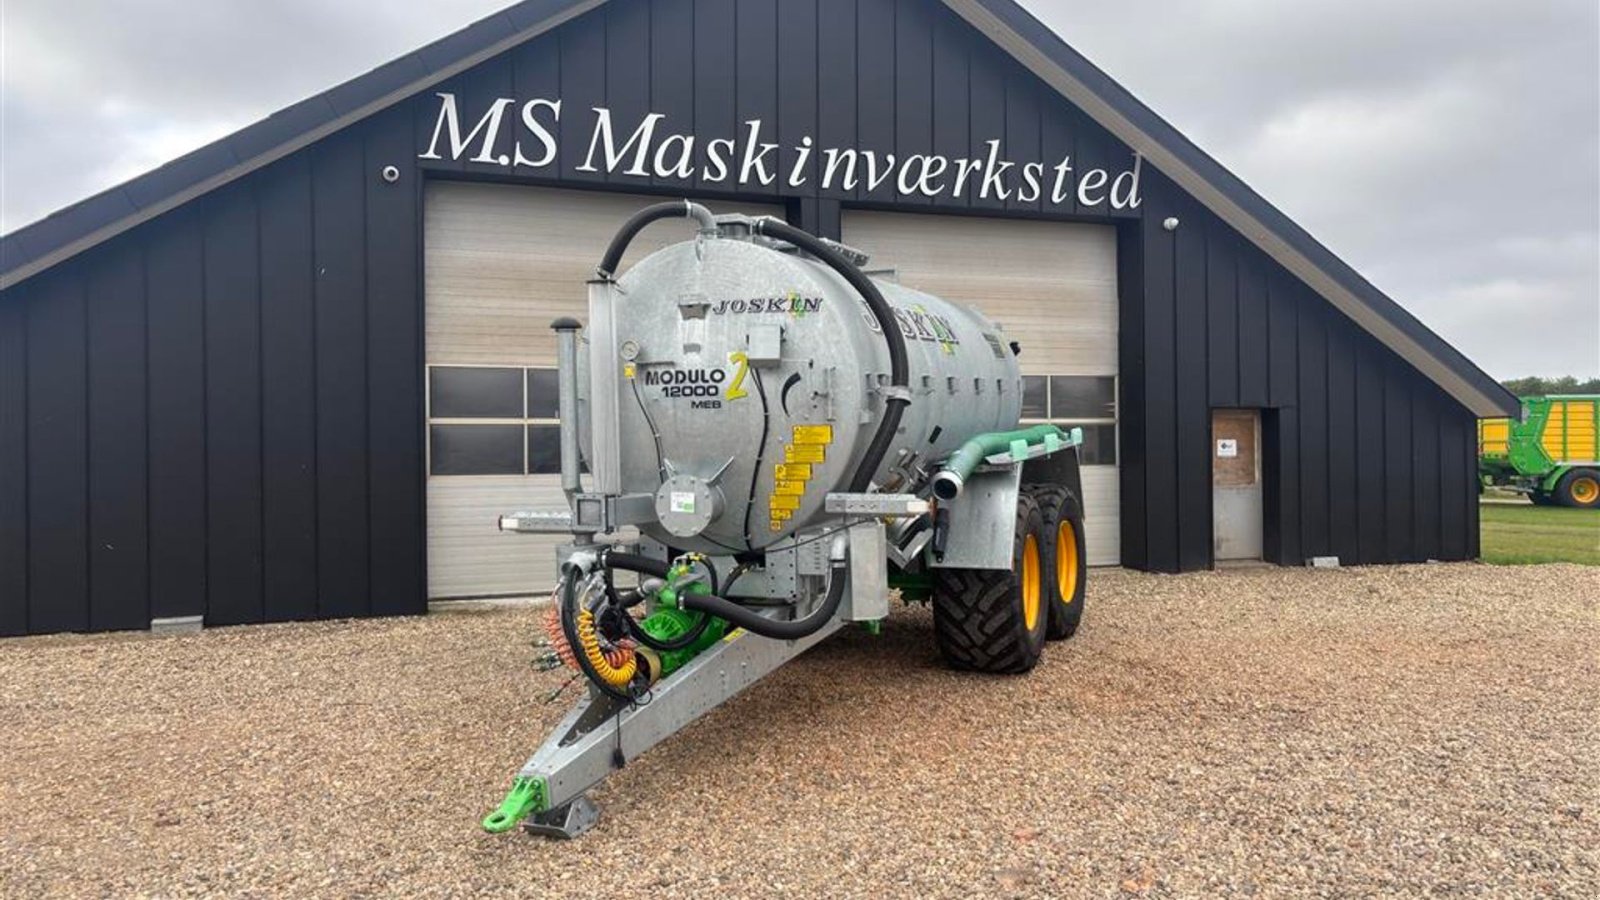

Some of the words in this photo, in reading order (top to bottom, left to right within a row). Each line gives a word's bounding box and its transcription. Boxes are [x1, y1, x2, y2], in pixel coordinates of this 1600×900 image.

[418, 92, 562, 168] M.S
[712, 296, 823, 316] JOSKIN
[860, 299, 960, 347] JSKIN
[645, 369, 726, 386] MODULO
[725, 351, 748, 401] 2
[661, 385, 719, 397] 12000
[691, 400, 722, 409] MEB
